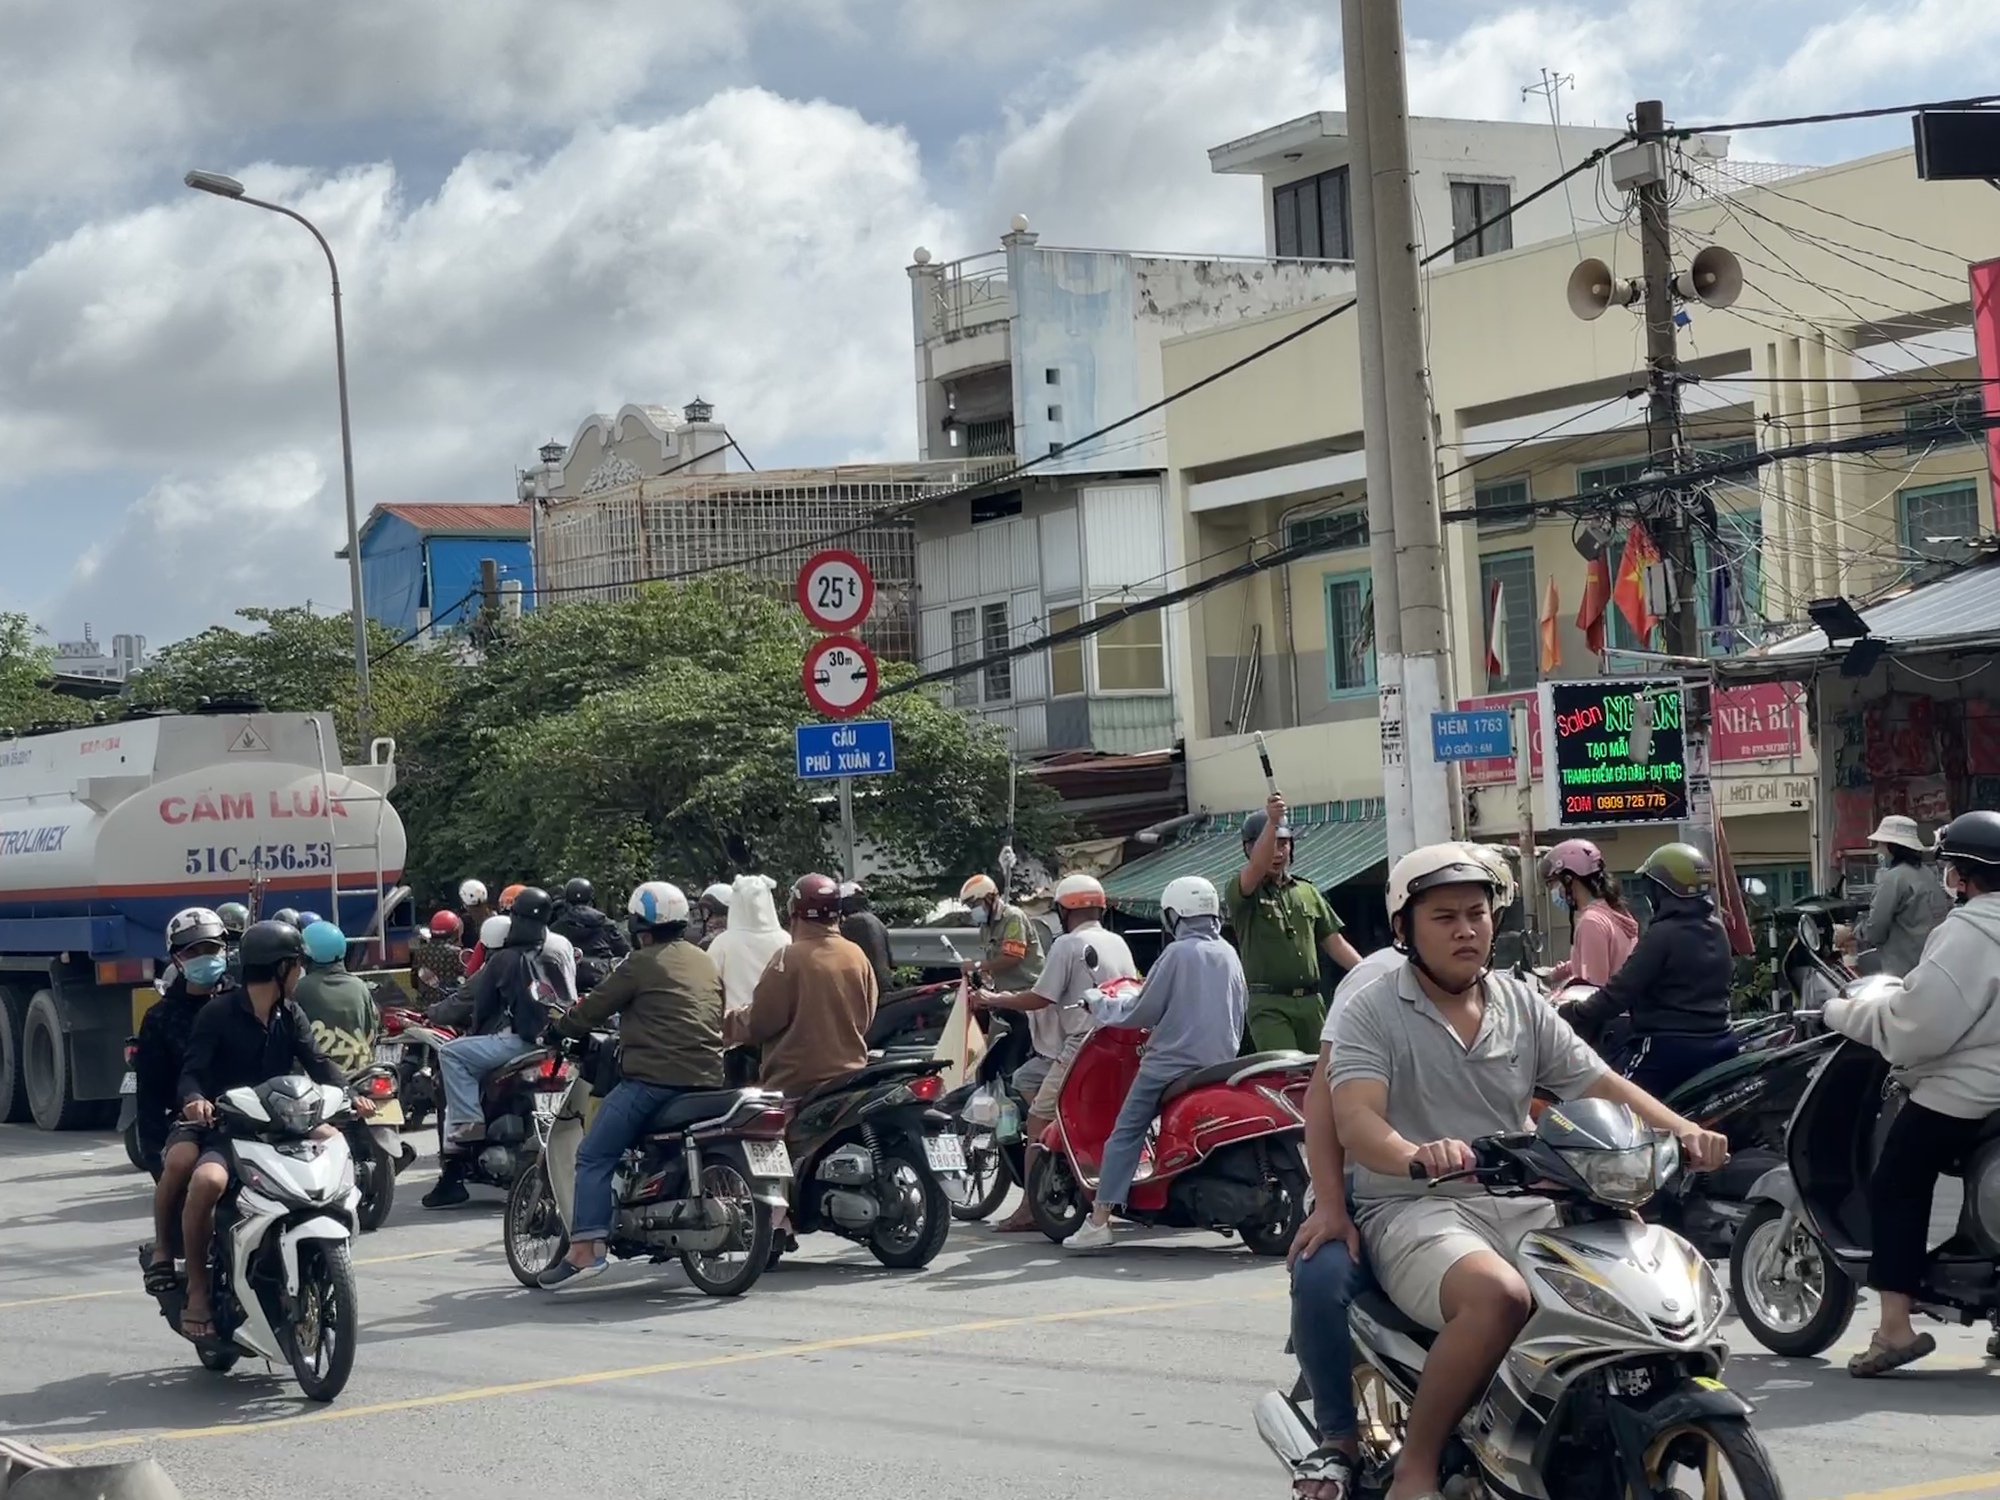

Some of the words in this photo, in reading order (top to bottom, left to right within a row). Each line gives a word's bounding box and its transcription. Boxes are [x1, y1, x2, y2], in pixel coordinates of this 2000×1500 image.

[818, 576, 844, 609] 25
[1474, 718, 1503, 733] 1763
[1557, 705, 1603, 737] Salon
[1718, 697, 1763, 735] NHÀ
[831, 725, 857, 747] CẦU
[805, 751, 831, 772] PHÚ
[838, 748, 871, 770] XUÂN
[878, 751, 886, 767] 2
[1585, 742, 1607, 760] TẠO
[1614, 763, 1627, 782] CÔ
[1662, 761, 1683, 782] TIỆC
[1596, 796, 1624, 810] 0909
[185, 841, 333, 875] 51C-456.53
